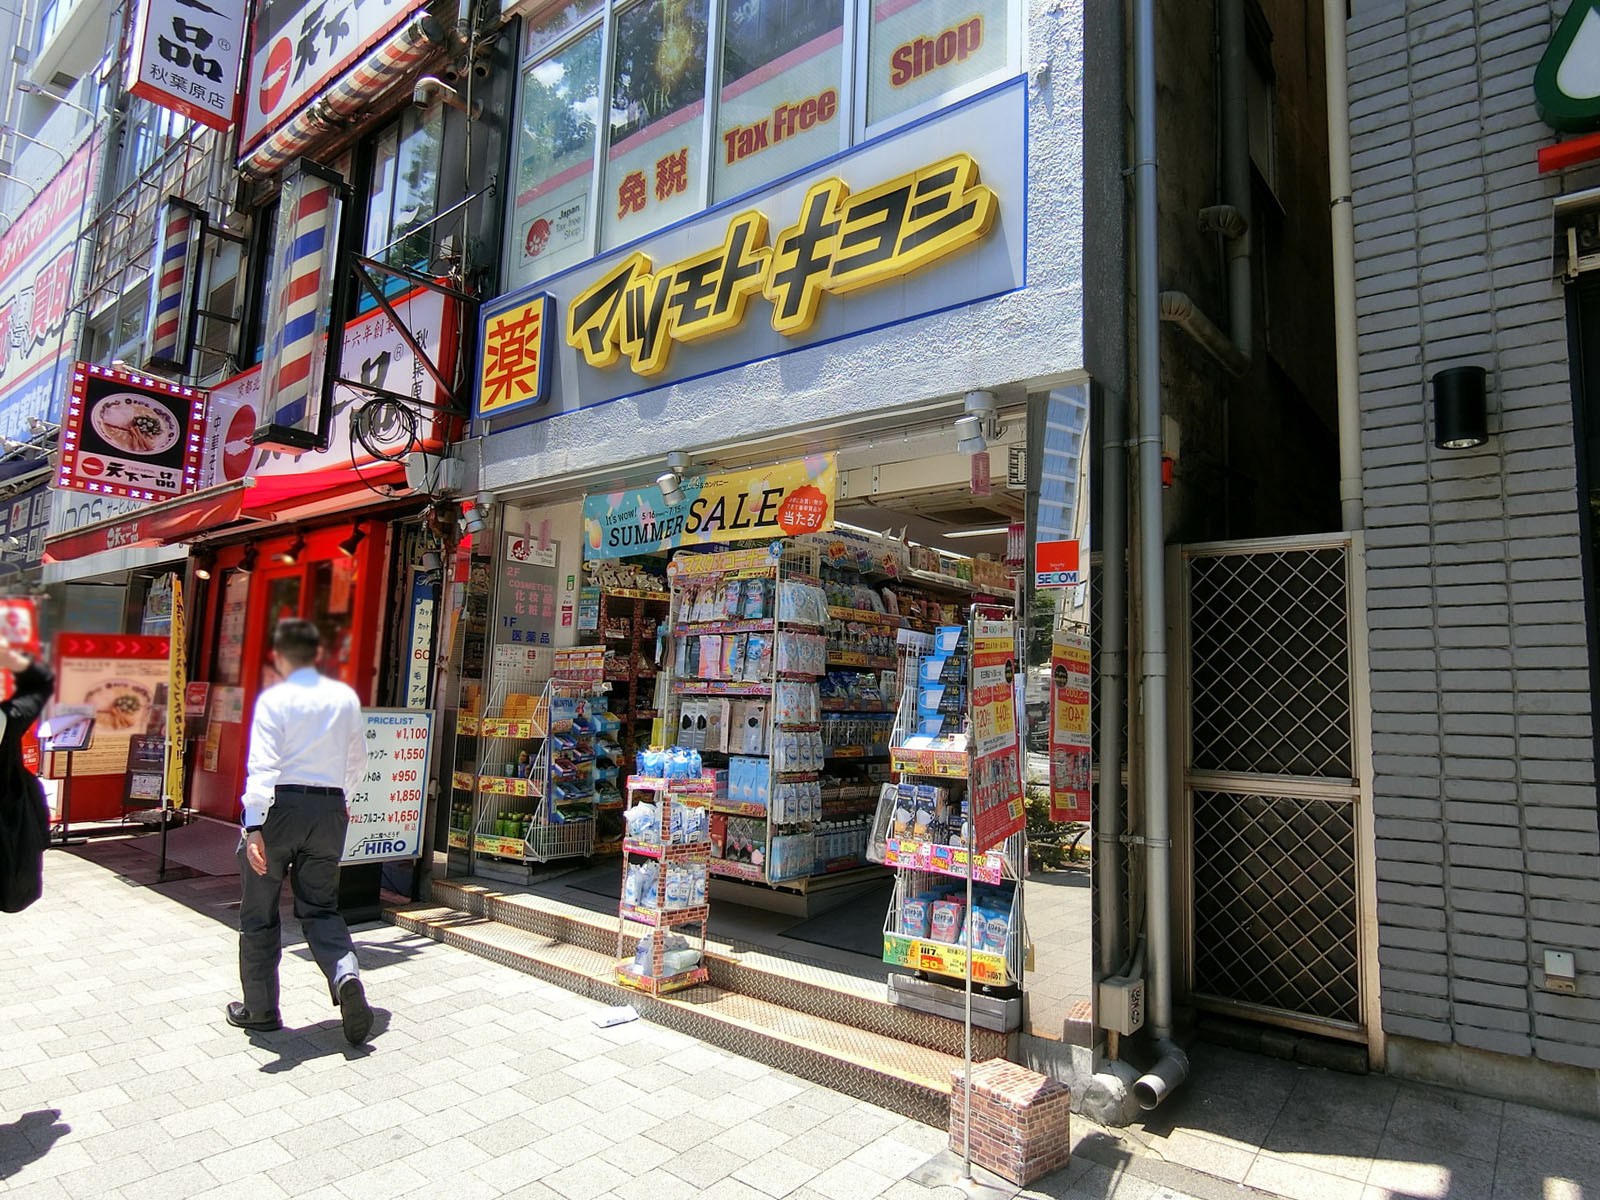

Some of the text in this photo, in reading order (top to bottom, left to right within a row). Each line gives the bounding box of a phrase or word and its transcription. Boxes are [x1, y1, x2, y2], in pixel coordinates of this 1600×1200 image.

[149, 63, 226, 110] 秋葉原店
[723, 14, 984, 166] Tax Free Shop
[559, 205, 580, 220] Japan
[567, 166, 985, 369] マツモトキヨシ
[484, 307, 540, 408] 薬
[105, 461, 176, 489] 天下一品
[605, 506, 637, 526] It's wow!
[608, 487, 785, 547] SUMMER SALE
[506, 566, 521, 577] 2F
[1037, 572, 1077, 585] SECOM
[503, 615, 517, 628] 1F
[511, 629, 551, 644] 医薬品
[367, 716, 415, 725] PRICELIST
[396, 727, 428, 742] ¥1,100
[394, 748, 425, 762] ¥1,550
[391, 769, 418, 783] ¥950
[389, 789, 422, 804] ¥1,850
[387, 809, 419, 826] ¥1,650
[364, 839, 407, 856] HIRO
